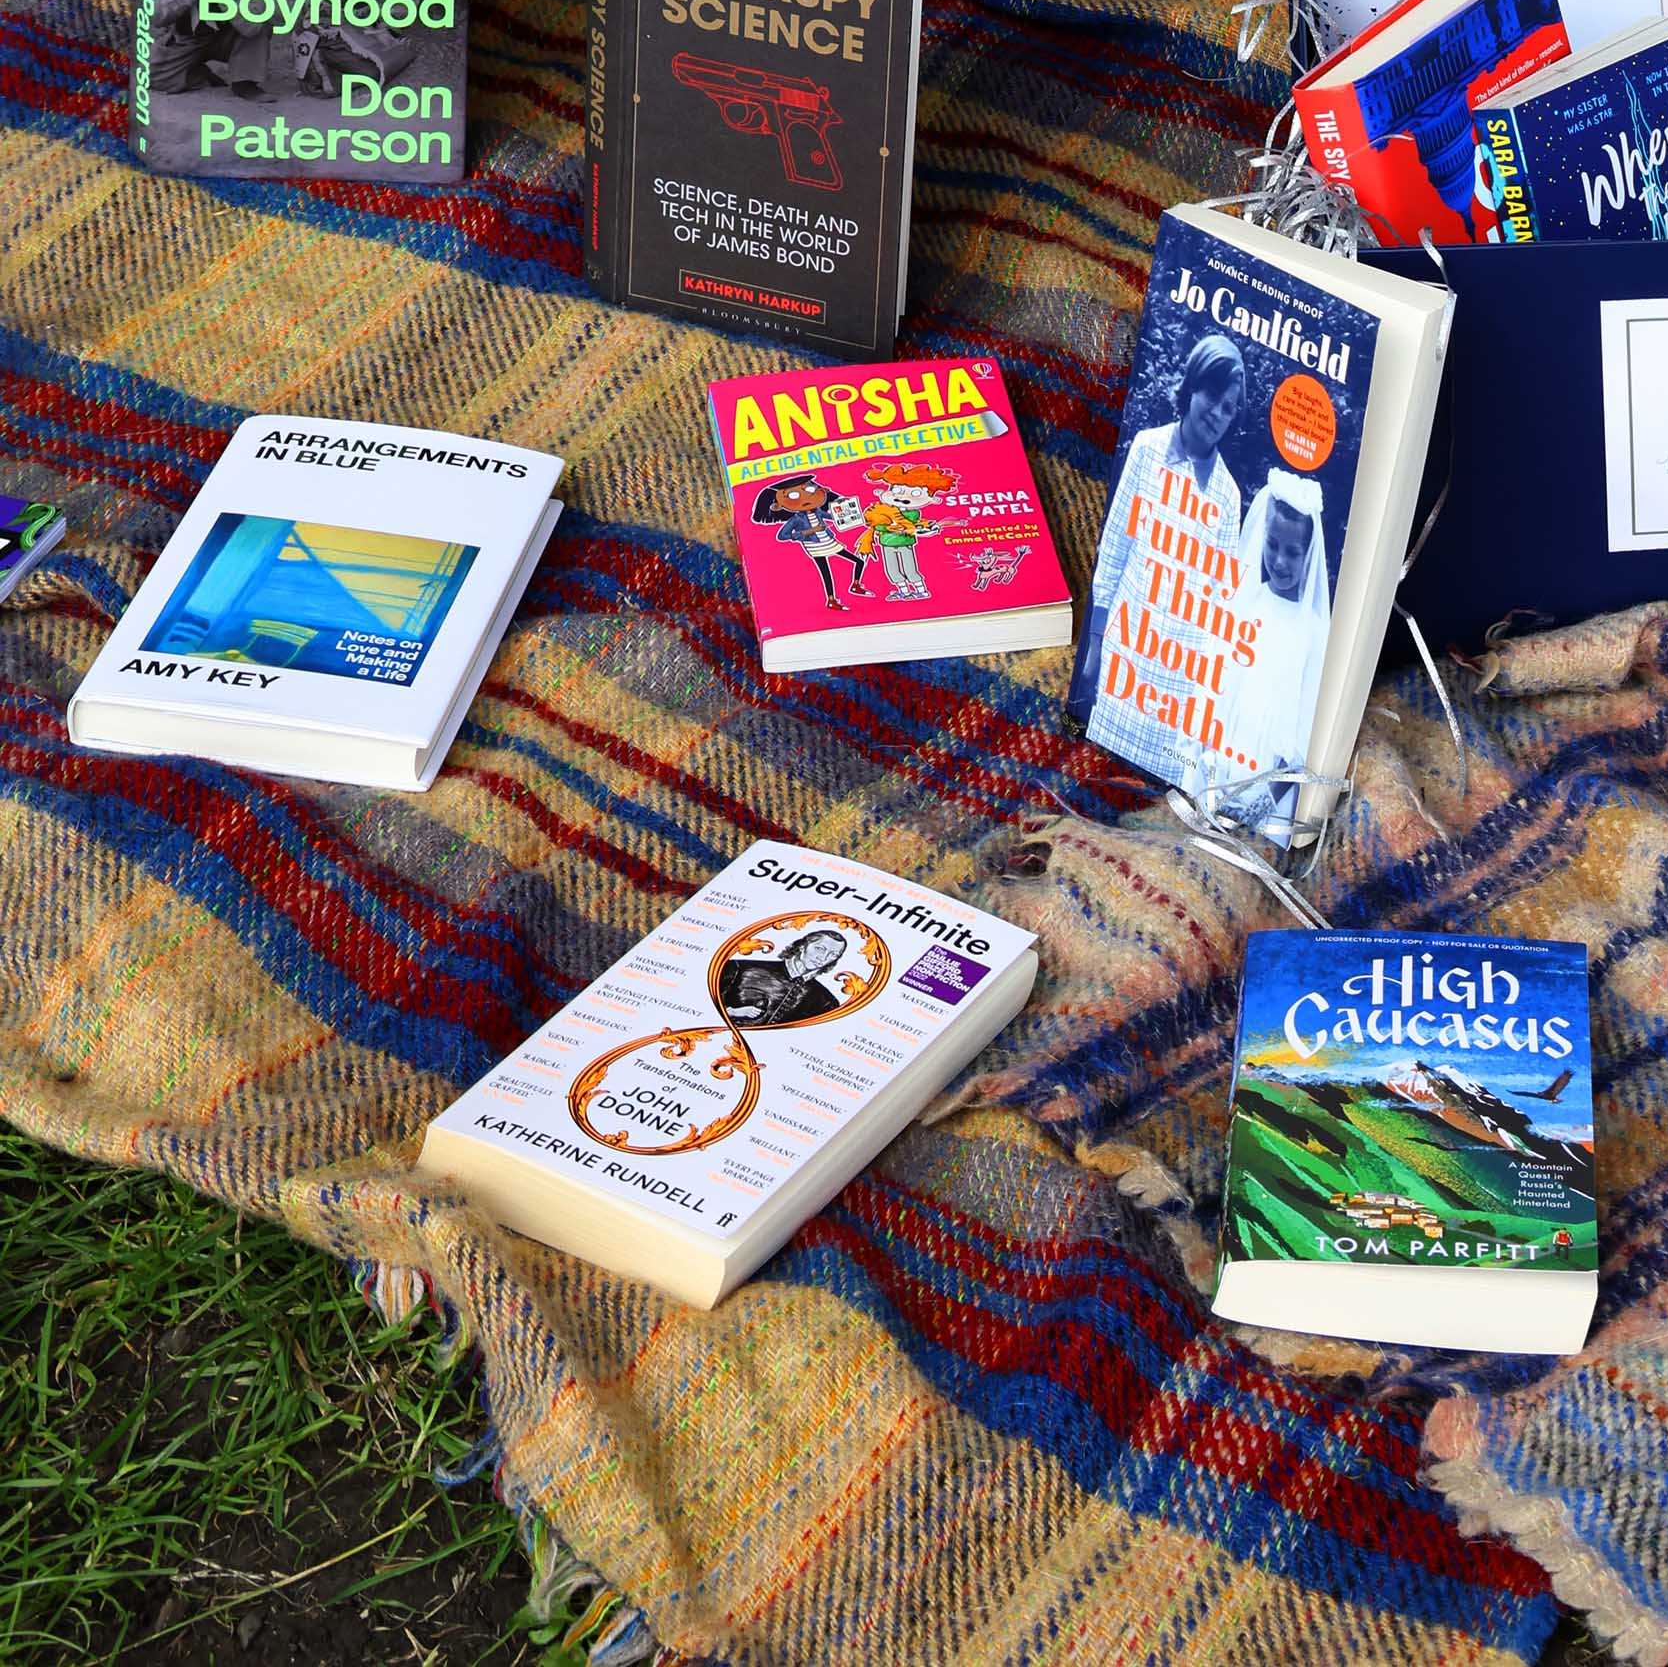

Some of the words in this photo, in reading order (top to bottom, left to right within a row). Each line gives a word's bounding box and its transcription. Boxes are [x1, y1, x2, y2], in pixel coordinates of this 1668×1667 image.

[341, 74, 453, 119] Don
[199, 114, 453, 164] Paterson
[1314, 110, 1340, 142] THE
[1324, 148, 1351, 181] SPY
[653, 178, 742, 213] SCIENCE,
[747, 195, 808, 229] DEATH
[814, 209, 859, 237] AND
[659, 199, 710, 226] TECH
[714, 211, 735, 232] IN
[740, 216, 775, 242] THE
[779, 225, 851, 257] WORLD
[674, 225, 702, 245] OF
[706, 233, 771, 262] JAMES
[775, 247, 835, 275] BOND
[684, 275, 754, 305] KATHRYN
[758, 289, 822, 318] HARKUP
[702, 307, 802, 335] BLOOMSBURY
[1170, 267, 1207, 315] Jo
[1209, 286, 1350, 385] Caulfield
[255, 446, 292, 461] IN
[294, 450, 381, 473] BLUE
[259, 430, 530, 480] ARRANGEMENTS
[740, 445, 858, 480] ACCIDENTAL
[863, 421, 983, 455] DETECTIVE
[945, 490, 1030, 507] SERENA
[969, 503, 1034, 517] PATEL
[1158, 467, 1221, 531] The
[1126, 495, 1248, 605] Funny
[1144, 558, 1262, 669] Thing
[336, 640, 377, 659] Love
[380, 646, 419, 660] and
[342, 629, 395, 646] Notes
[398, 639, 423, 650] on
[1105, 603, 1229, 696] About
[118, 658, 206, 686] AMY
[206, 669, 280, 689] KEY
[345, 652, 413, 672] Making
[357, 668, 369, 677] a
[373, 667, 408, 682] Life
[1103, 652, 1258, 772] Death...
[748, 857, 992, 957] Super-Infinite
[1343, 953, 1521, 1009] High
[1283, 992, 1574, 1060] Caucasus
[633, 1058, 726, 1100] Transformations
[662, 1084, 676, 1093] of
[679, 1061, 701, 1076] The
[598, 1093, 684, 1137] DONNE
[622, 1086, 691, 1118] JOHN
[474, 1114, 602, 1169] KATHERINE
[602, 1160, 707, 1215] RUNDELL
[1316, 1236, 1389, 1256] TOM
[1409, 1240, 1540, 1261] PARFITT
